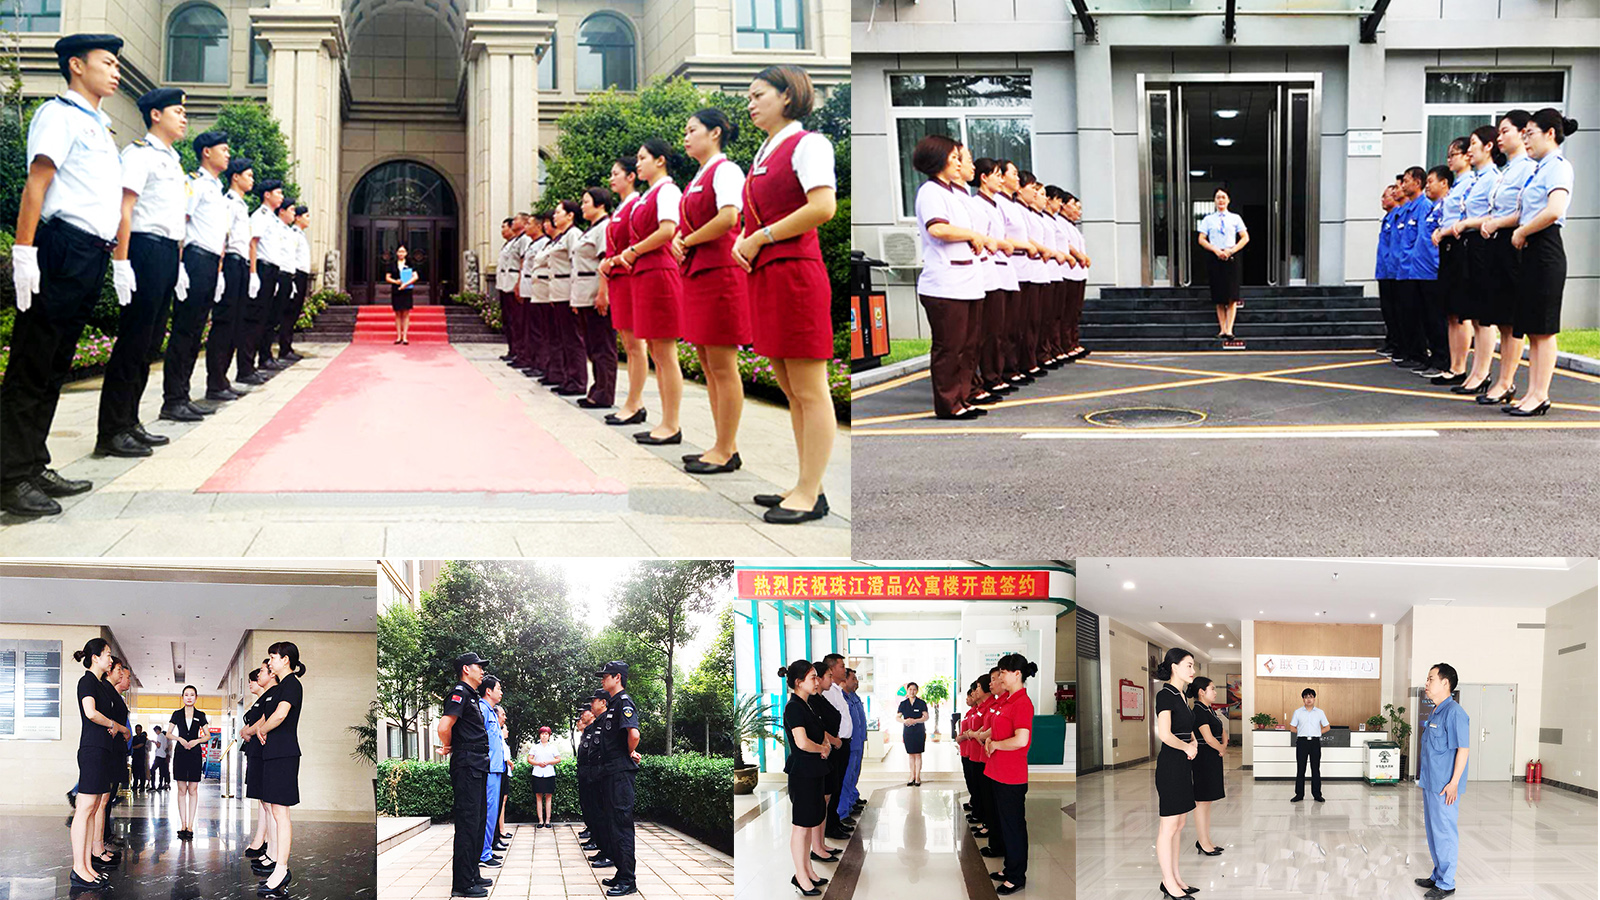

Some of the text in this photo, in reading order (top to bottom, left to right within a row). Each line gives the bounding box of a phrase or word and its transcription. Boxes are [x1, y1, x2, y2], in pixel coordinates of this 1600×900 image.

[754, 575, 1035, 596] 热烈庆祝珠江澄品公寓楼开盘签约
[1279, 658, 1374, 672] 联合财富中心
